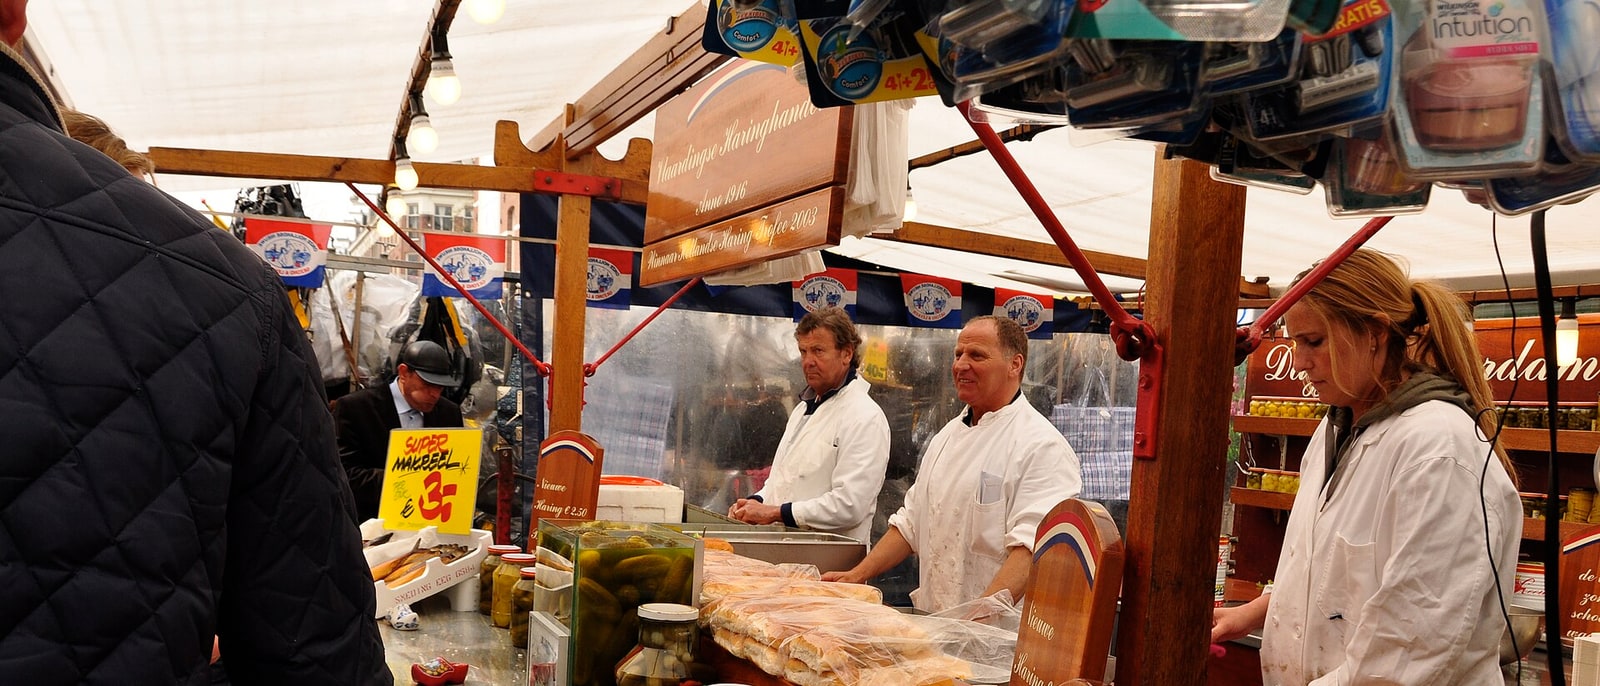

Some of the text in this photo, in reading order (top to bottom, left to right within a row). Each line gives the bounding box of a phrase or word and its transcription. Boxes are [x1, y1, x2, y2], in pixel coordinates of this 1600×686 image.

[733, 30, 760, 42] Comfort
[1433, 15, 1532, 38] Intuition
[841, 76, 869, 89] Comfort
[695, 180, 748, 216] Anno 1916
[647, 250, 677, 270] Winnaar
[719, 225, 753, 254] Haring
[756, 211, 788, 247] Trofee
[790, 206, 818, 231] 2003
[404, 433, 449, 456] SUPER
[391, 449, 461, 472] MAKREEL
[536, 478, 567, 492] Nieuwe
[534, 499, 563, 518] Haring
[1578, 568, 1597, 582] de
[1027, 600, 1055, 641] Nieuwe
